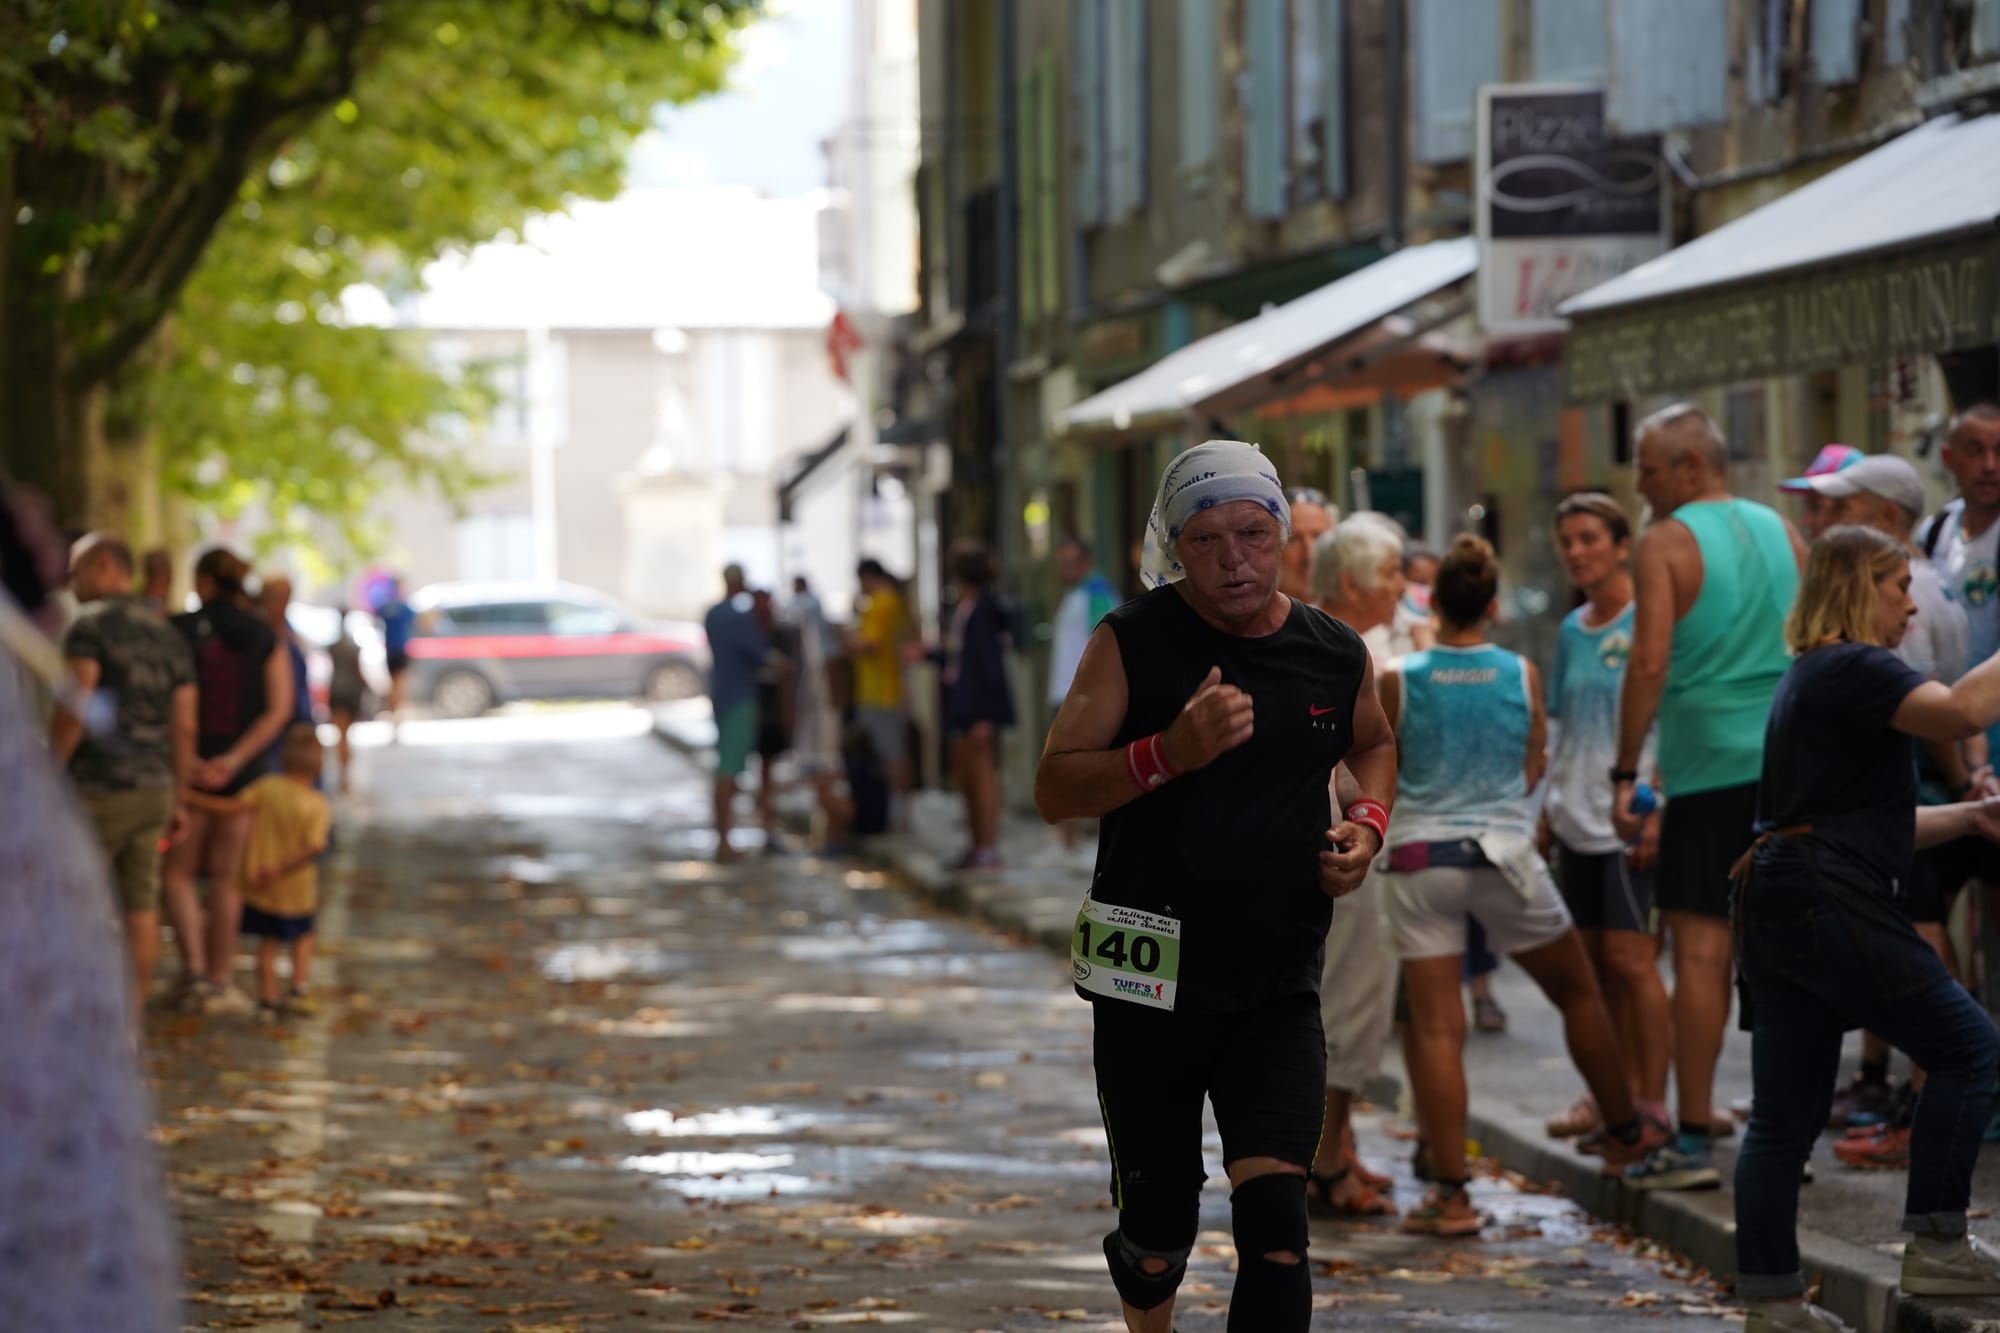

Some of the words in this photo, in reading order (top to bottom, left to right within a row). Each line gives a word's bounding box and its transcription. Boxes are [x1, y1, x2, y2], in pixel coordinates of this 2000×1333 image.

[1312, 720, 1336, 731] AIR
[1112, 908, 1153, 923] Challenge
[1157, 919, 1171, 927] des
[1079, 920, 1161, 973] 140
[1112, 977, 1152, 993] TUFF'S
[1115, 985, 1155, 999] Aventure
